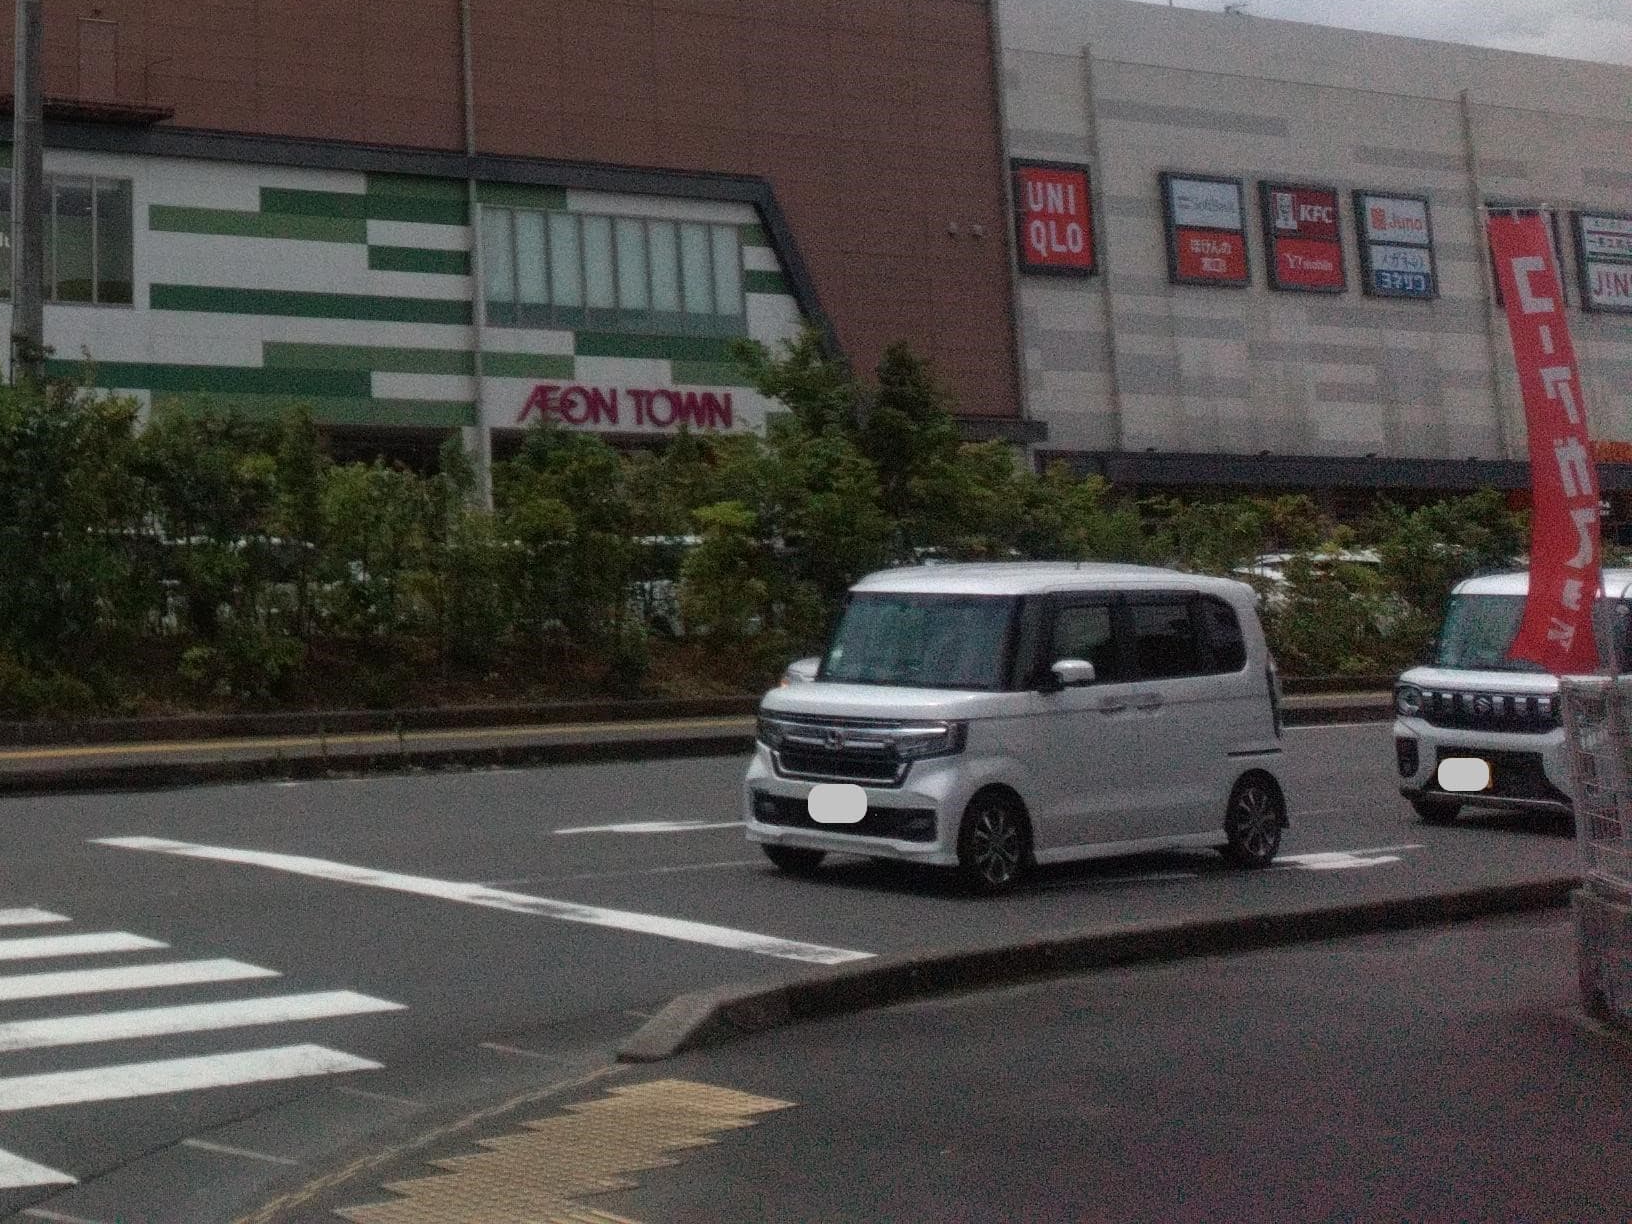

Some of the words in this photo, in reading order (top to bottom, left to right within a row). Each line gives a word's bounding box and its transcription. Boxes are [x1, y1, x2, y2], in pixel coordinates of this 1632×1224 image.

[1027, 181, 1076, 215] UNI
[1300, 204, 1333, 223] KFC
[1030, 219, 1083, 257] QLO
[626, 387, 733, 428] TOWN
